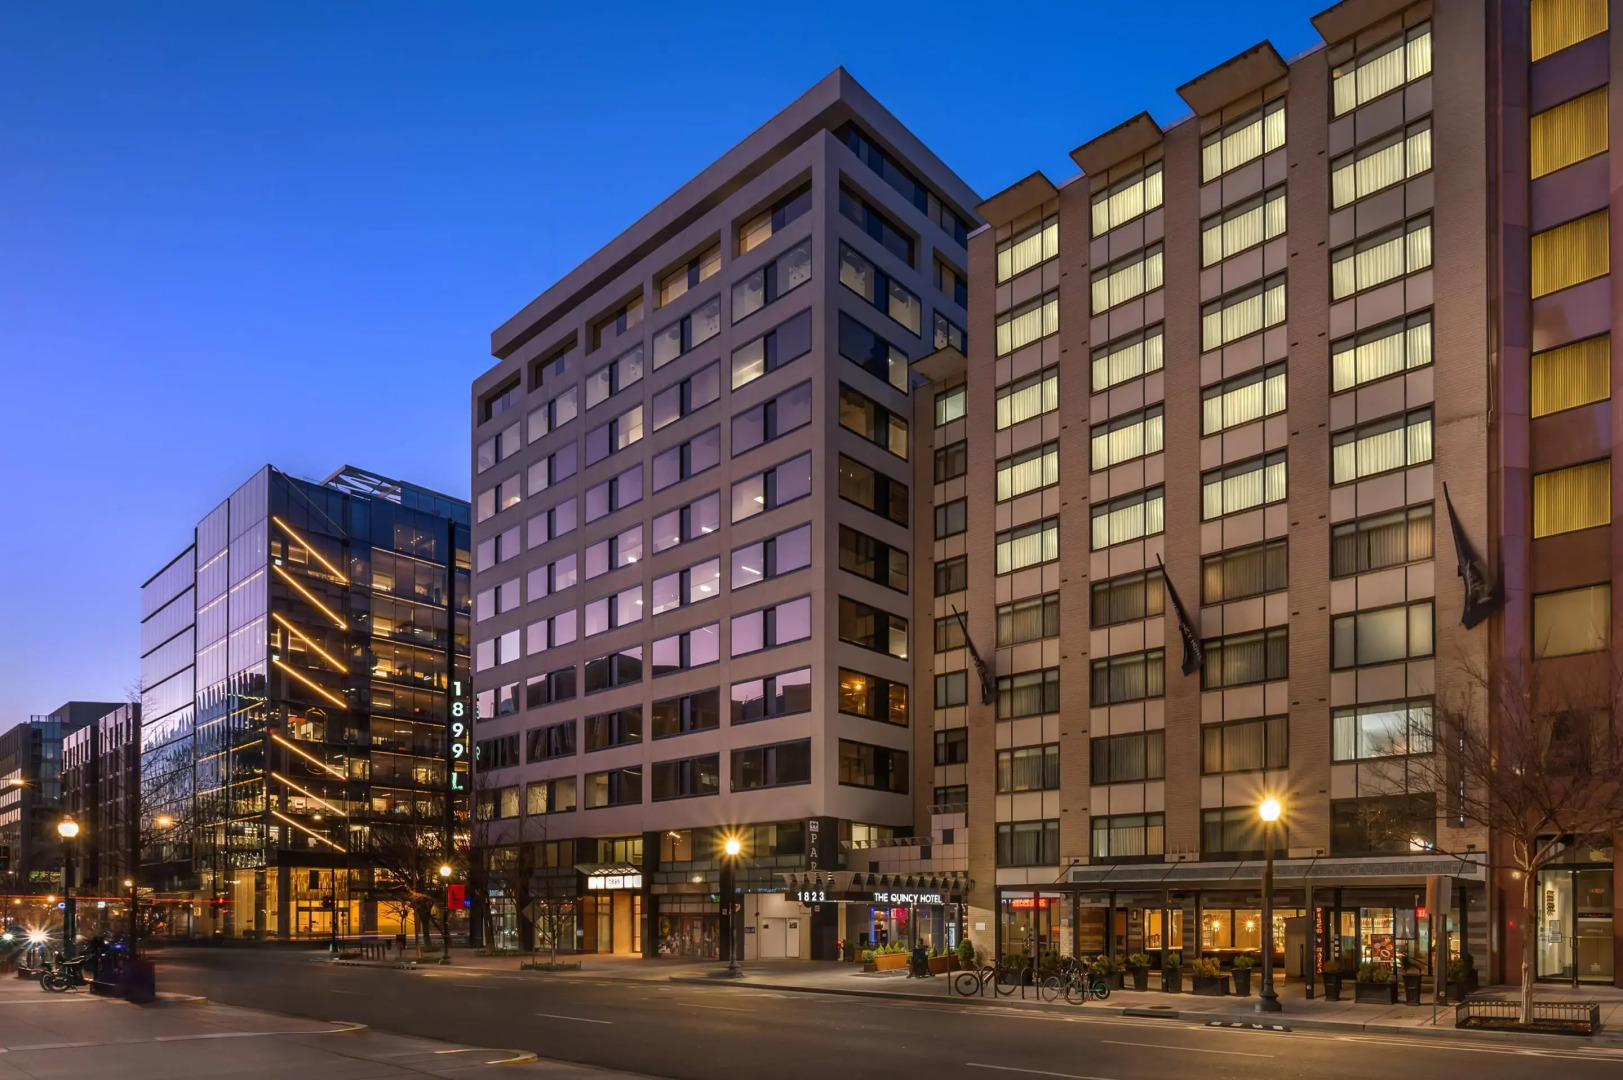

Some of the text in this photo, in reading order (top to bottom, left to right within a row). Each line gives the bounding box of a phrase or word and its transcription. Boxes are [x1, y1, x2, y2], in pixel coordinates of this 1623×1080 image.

[451, 681, 464, 790] 1899 L
[797, 891, 825, 901] 1823
[874, 892, 942, 903] THE QUINCY HOTEL
